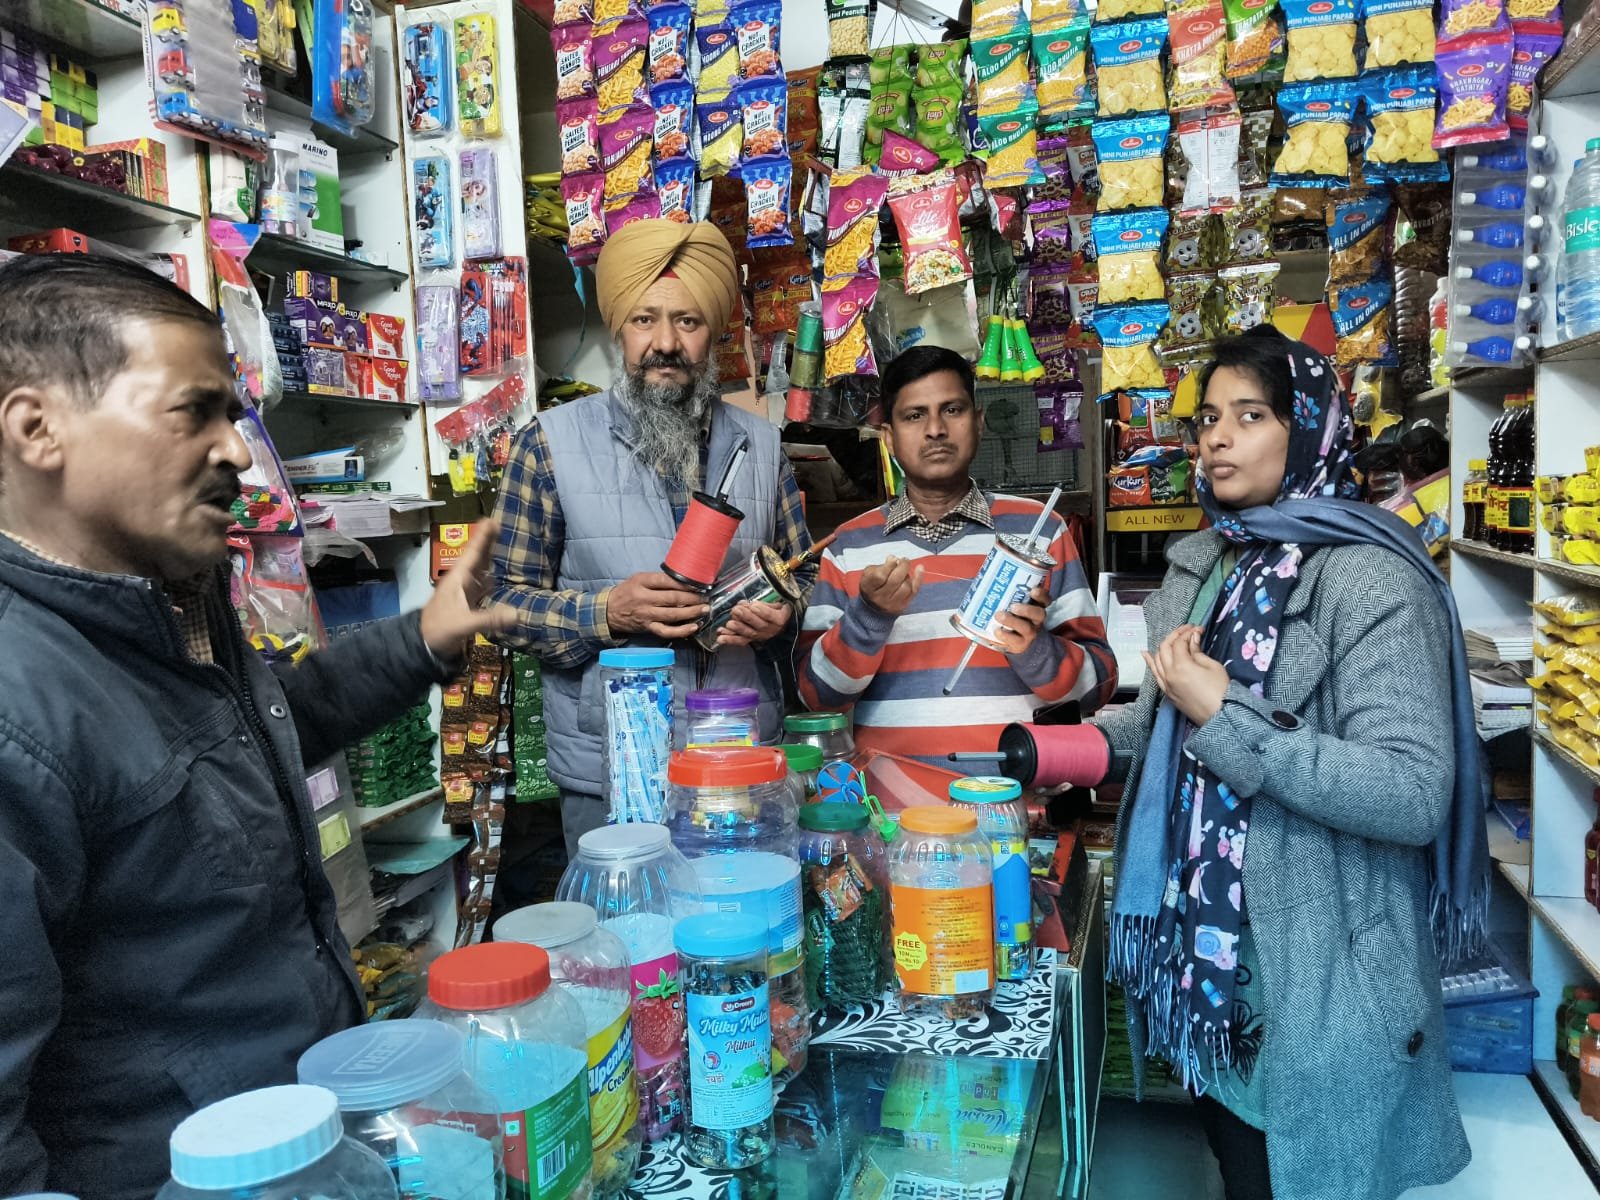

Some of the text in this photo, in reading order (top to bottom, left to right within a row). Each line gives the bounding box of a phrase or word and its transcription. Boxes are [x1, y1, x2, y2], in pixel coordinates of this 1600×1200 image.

[1383, 1, 1413, 11] PUNJABI
[841, 7, 866, 17] Peanuts
[1303, 15, 1331, 24] PUNJABI
[1332, 13, 1354, 21] PAPAD
[657, 37, 668, 46] NUT
[748, 32, 759, 40] NUT
[651, 40, 673, 57] CRACKER
[742, 35, 766, 52] CRACKER
[561, 52, 580, 65] SALTED
[1115, 52, 1140, 62] PUNJABI
[559, 56, 581, 73] PEANUTS
[981, 61, 999, 77] ALOO
[1512, 64, 1539, 74] NAGARI
[753, 111, 764, 119] NUT
[1300, 112, 1329, 120] PUNJABI
[655, 118, 677, 134] CRACKER
[746, 114, 771, 130] CRACKER
[565, 127, 583, 139] SALTED
[565, 132, 586, 147] PEANUTS
[302, 143, 328, 157] MARINO
[1115, 149, 1140, 157] PUNJABI
[757, 191, 769, 200] NUT
[750, 195, 775, 209] CRACKER
[1566, 216, 1600, 240] Bisle
[1334, 237, 1348, 248] ALL
[1350, 228, 1360, 240] IN
[1115, 243, 1141, 251] PUNJABI
[1141, 240, 1161, 249] PAPAD
[345, 310, 358, 318] AXO
[1355, 313, 1364, 326] IN
[1178, 364, 1189, 374] re
[1124, 514, 1185, 525] ALL NEW
[896, 938, 921, 948] FREE
[700, 1018, 738, 1036] Milky
